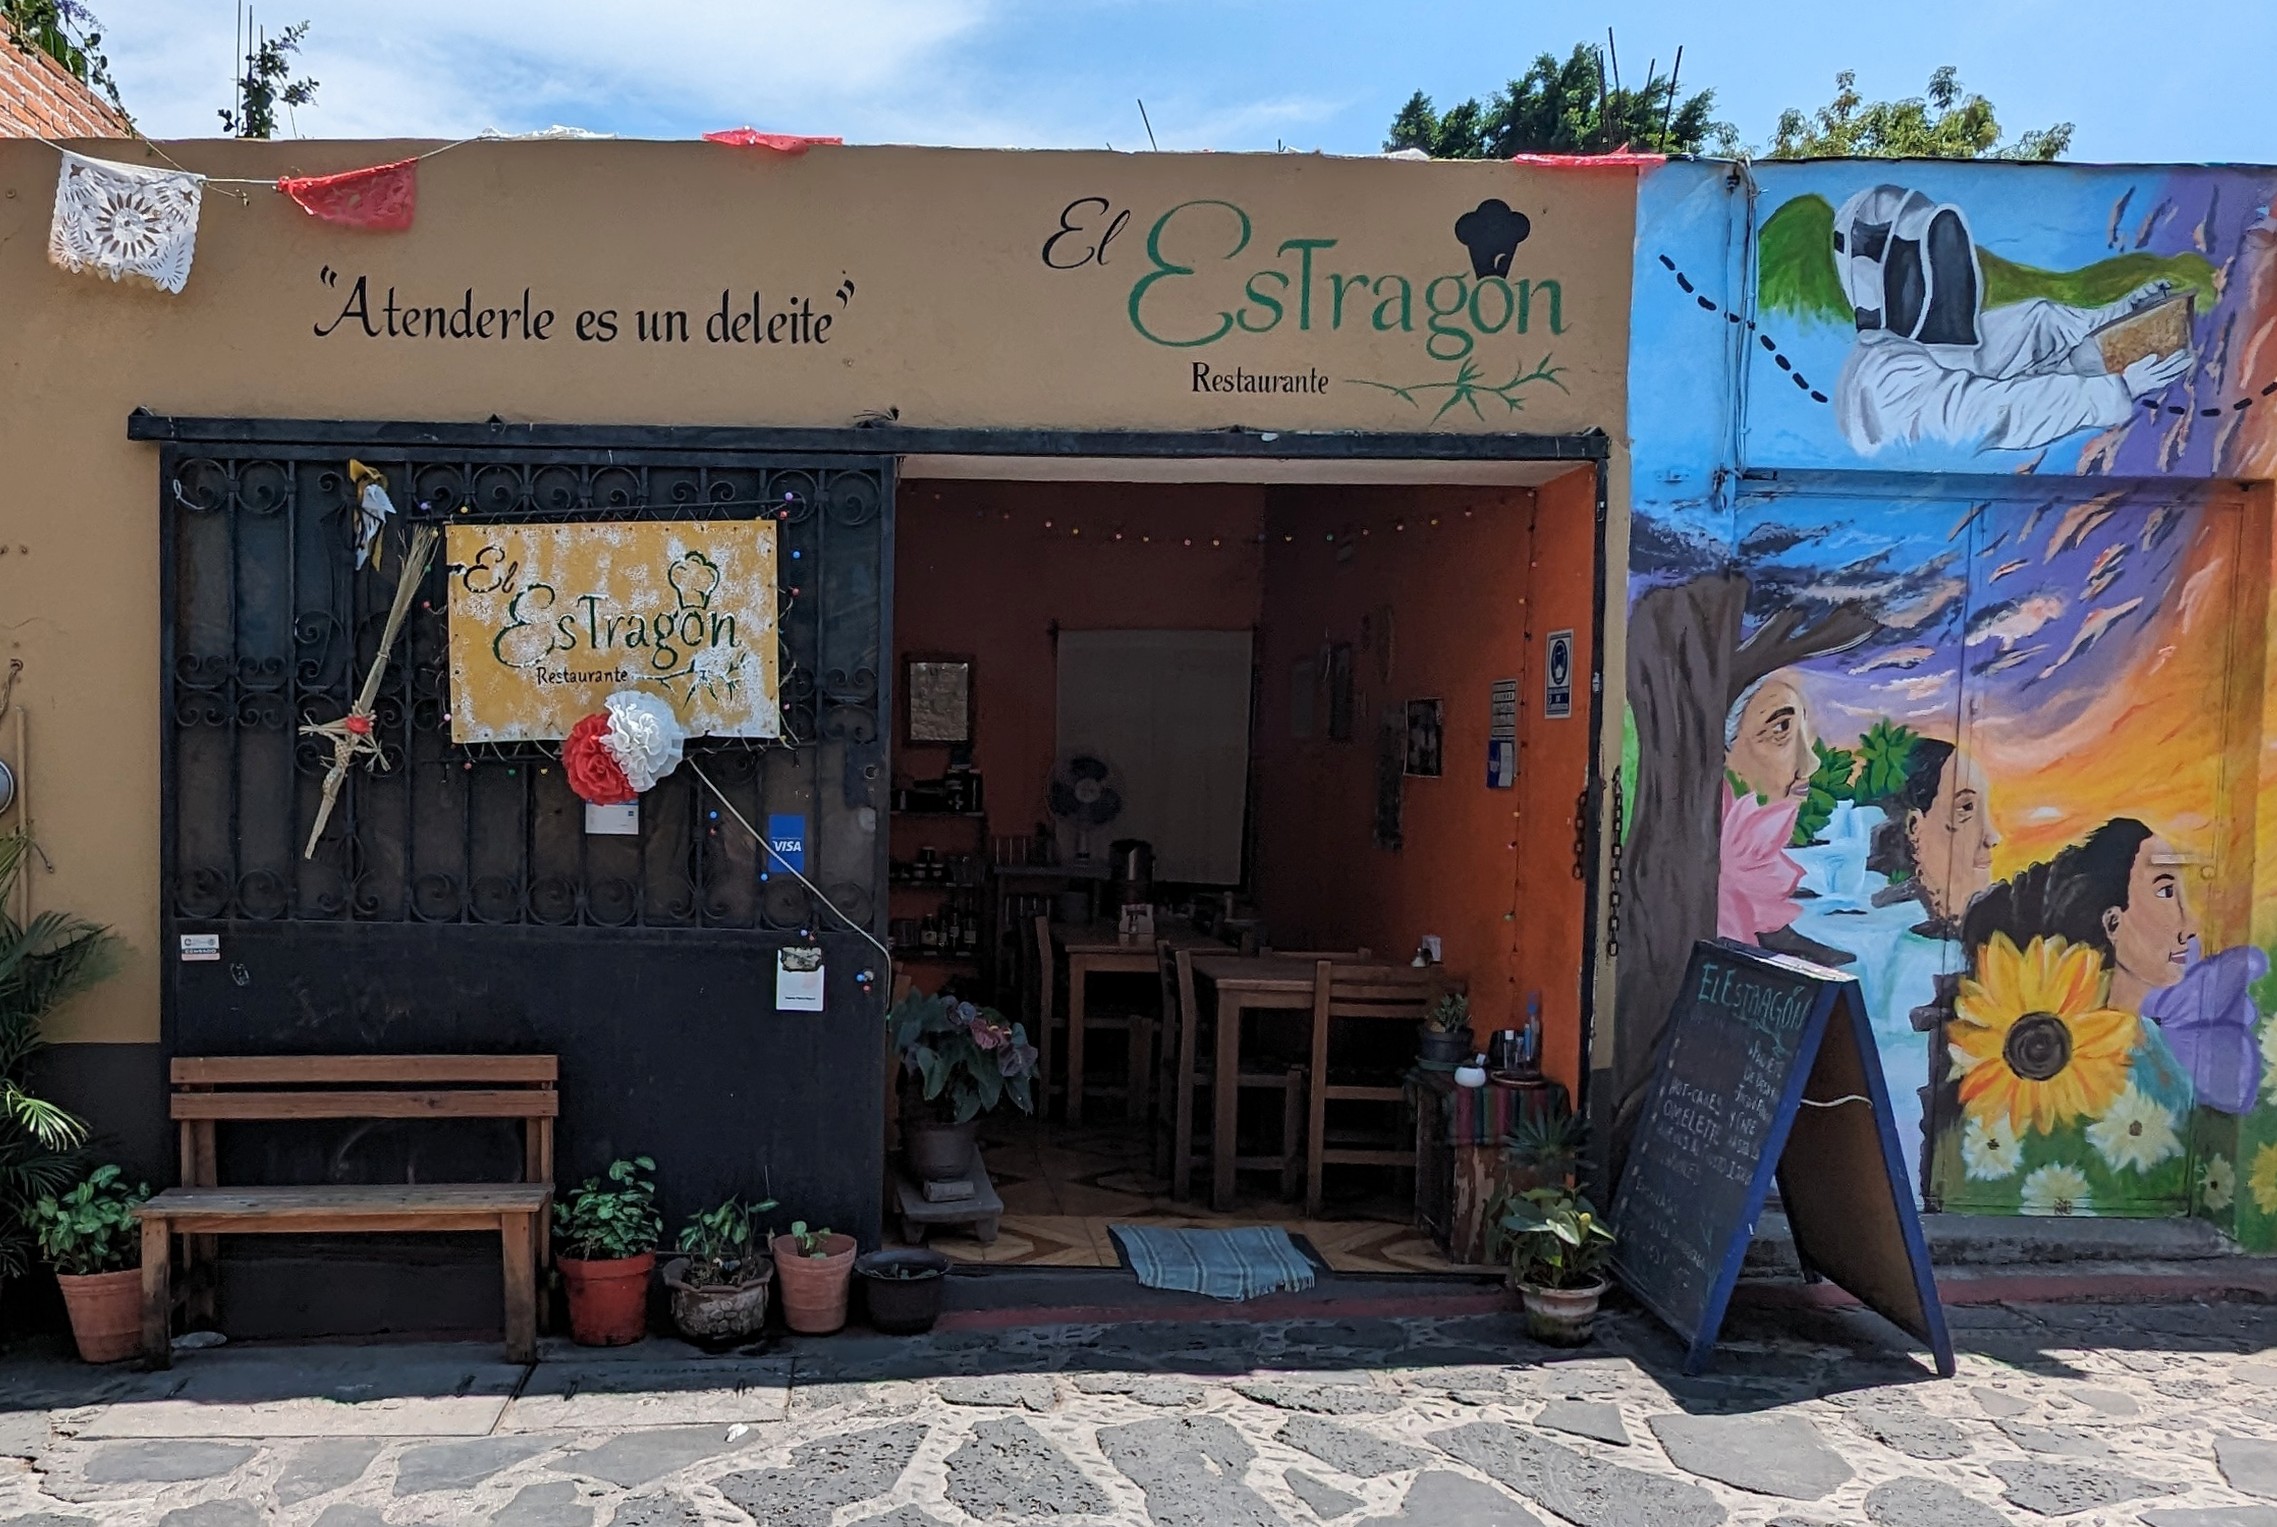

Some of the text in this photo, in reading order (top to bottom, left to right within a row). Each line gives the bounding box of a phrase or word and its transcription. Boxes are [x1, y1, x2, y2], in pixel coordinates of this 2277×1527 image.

[1041, 196, 1131, 270] El
[575, 309, 618, 342] es
[636, 310, 690, 343] un
[1191, 361, 1330, 396] Restaurante
[463, 546, 518, 594] El
[537, 666, 629, 686] Restaurante
[772, 840, 802, 852] VISA
